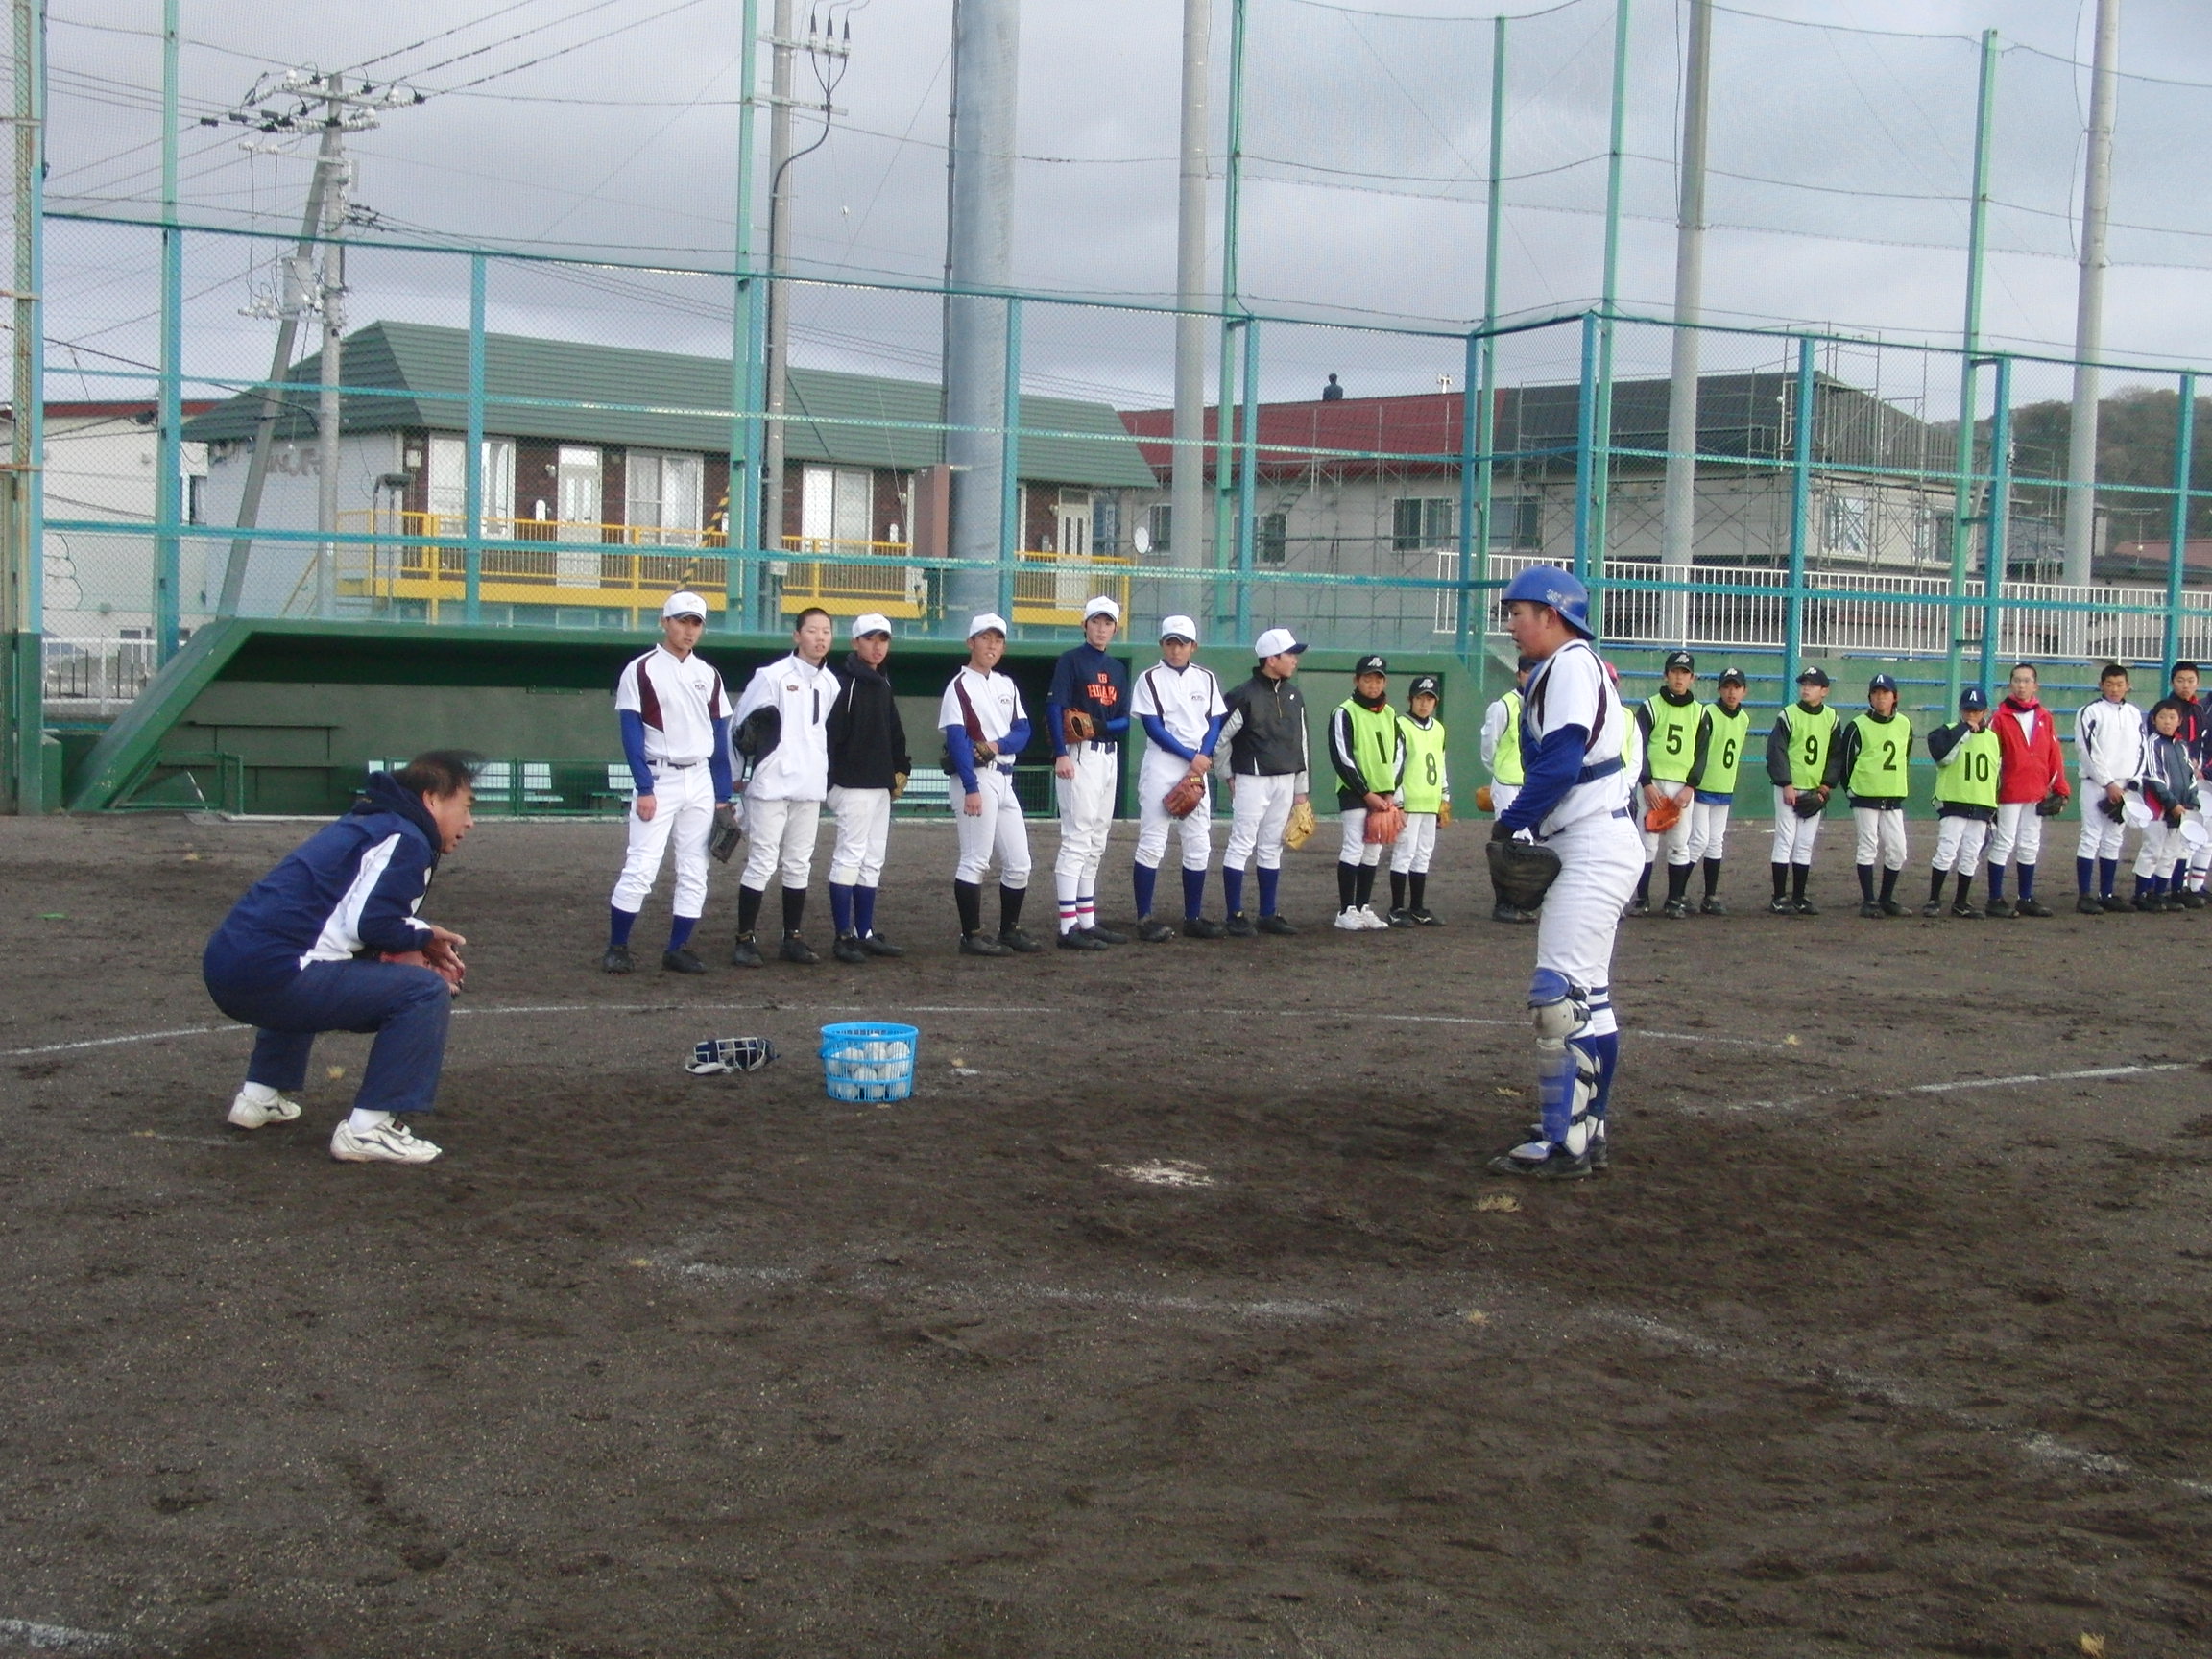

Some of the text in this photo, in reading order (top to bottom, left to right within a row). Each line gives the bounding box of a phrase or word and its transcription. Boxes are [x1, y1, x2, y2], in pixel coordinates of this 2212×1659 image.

[1969, 690, 1978, 702] A
[1375, 731, 1387, 764] 1
[1666, 723, 1683, 755] 5
[1722, 738, 1736, 769] 6
[1804, 735, 1818, 766] 9
[1425, 752, 1438, 786] 8
[1883, 739, 1897, 771] 2
[1964, 751, 1988, 782] 10
